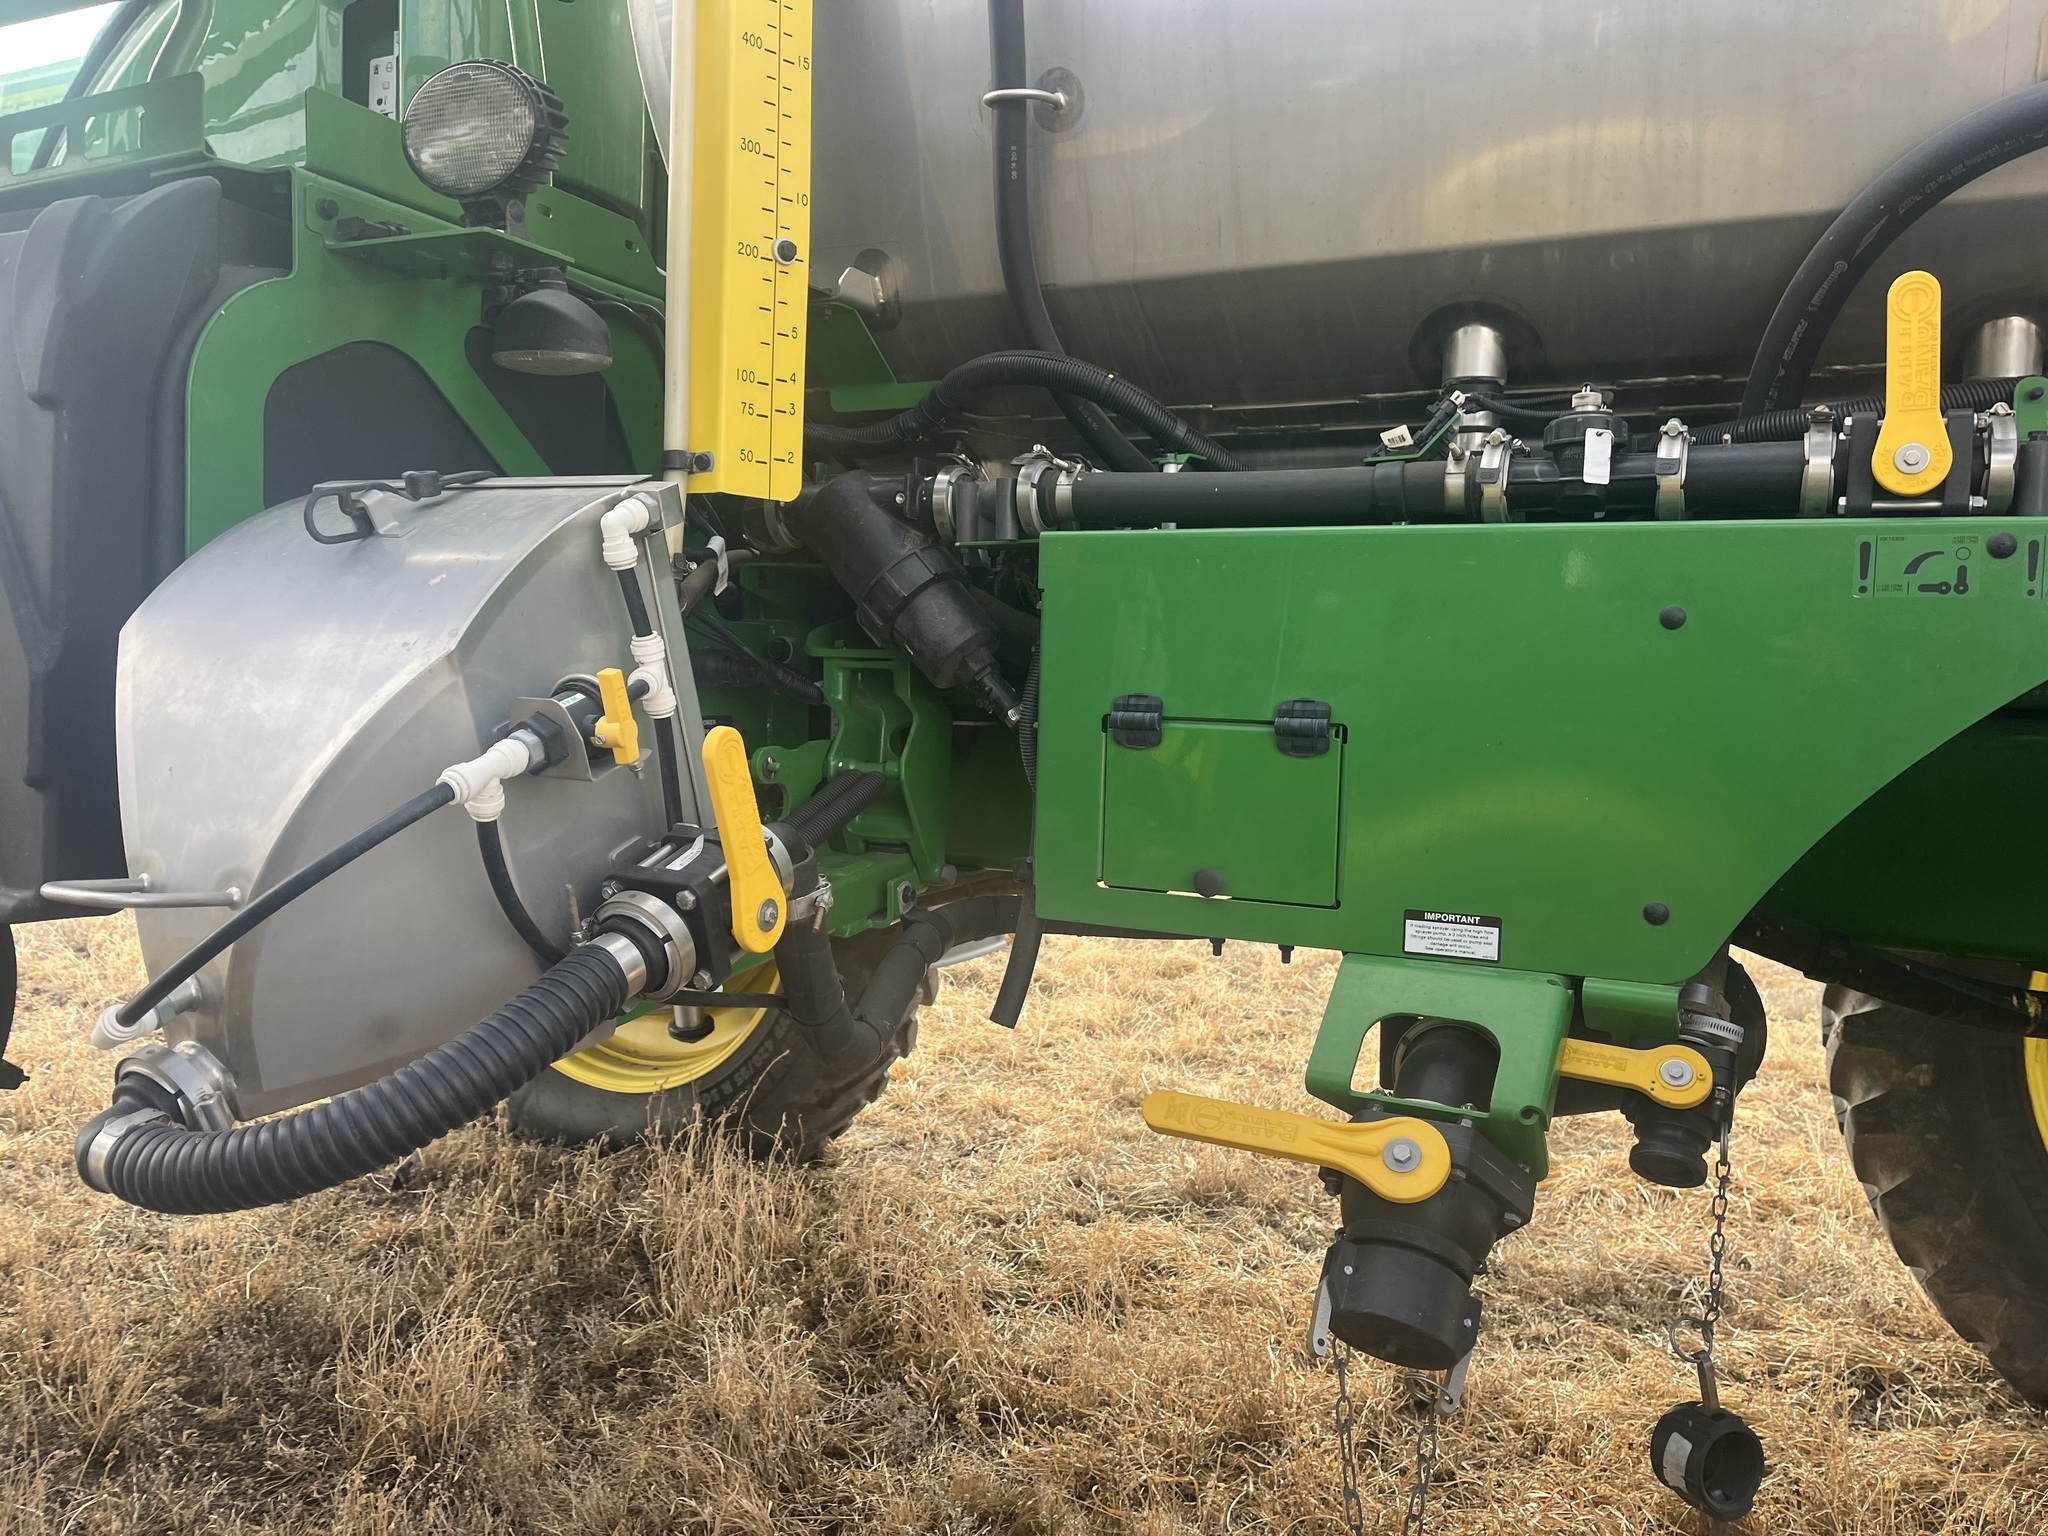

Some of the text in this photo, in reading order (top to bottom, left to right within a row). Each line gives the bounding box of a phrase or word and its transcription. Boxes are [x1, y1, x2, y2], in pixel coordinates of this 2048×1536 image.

[742, 31, 762, 50] 400
[798, 55, 810, 70] 15
[740, 138, 761, 155] 300
[796, 192, 809, 207] 10
[738, 242, 759, 259] 200
[1811, 259, 1848, 306] Continental
[791, 327, 798, 340] 5
[1781, 318, 1809, 363] FRONTIER
[736, 368, 755, 384] 100
[790, 372, 796, 385] 4
[741, 401, 755, 416] 75
[789, 403, 796, 416] 3
[739, 449, 754, 463] 50
[787, 451, 794, 464] 2
[1424, 912, 1480, 924] IMPORTANT
